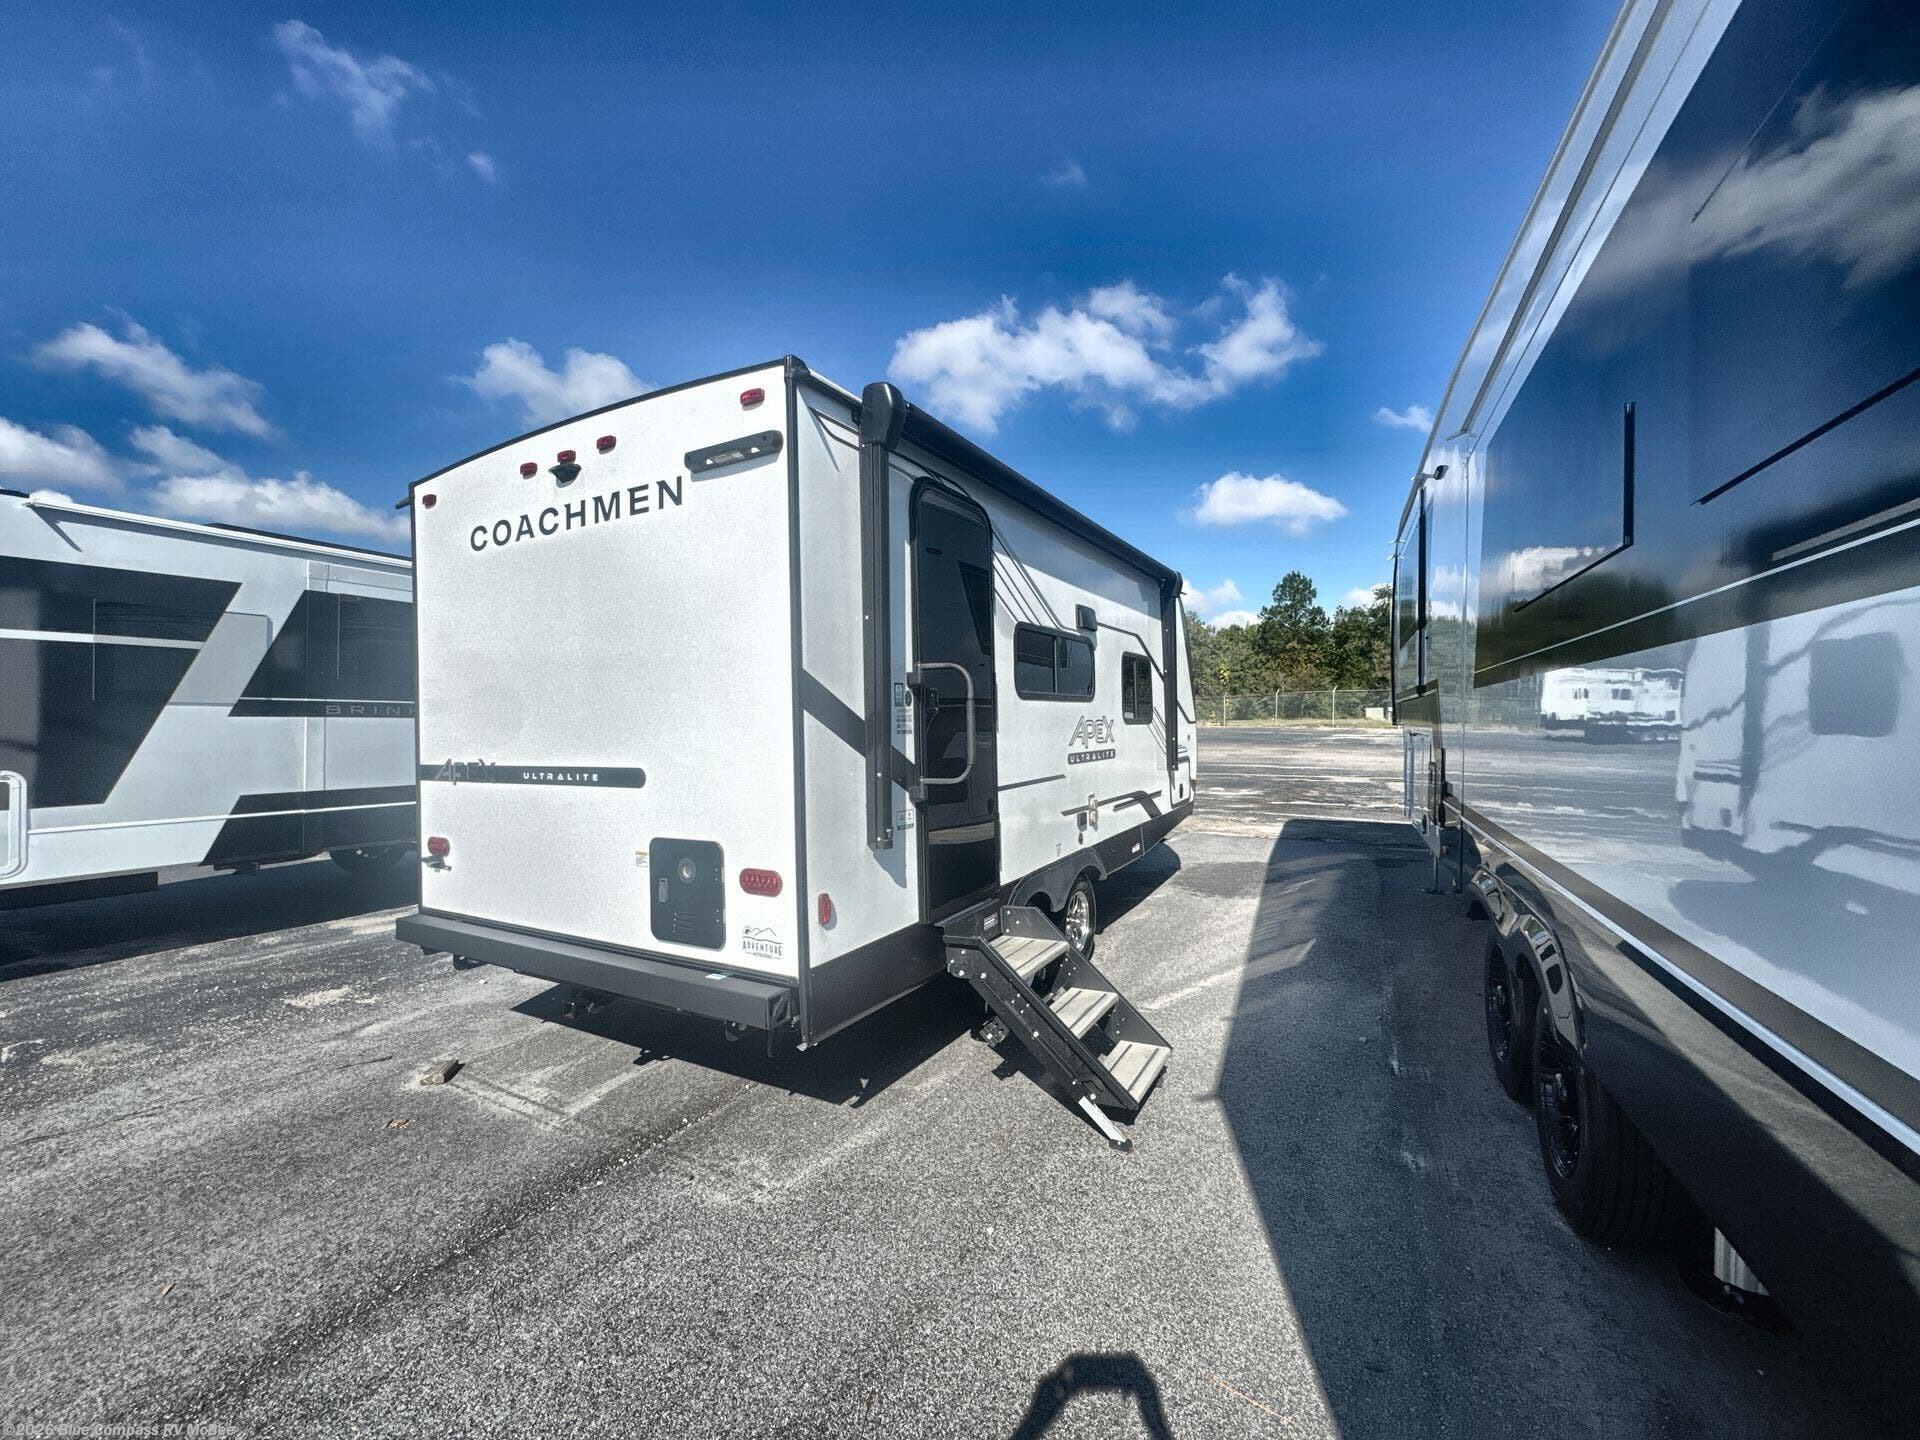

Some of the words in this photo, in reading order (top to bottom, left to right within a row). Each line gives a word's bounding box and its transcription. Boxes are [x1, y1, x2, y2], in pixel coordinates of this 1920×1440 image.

[470, 476, 683, 551] COACHMEN
[1069, 715, 1115, 749] APEX
[1070, 750, 1114, 763] ULTRALITE
[523, 772, 599, 781] ULTRALITE
[743, 940, 782, 955] ADVENTURE
